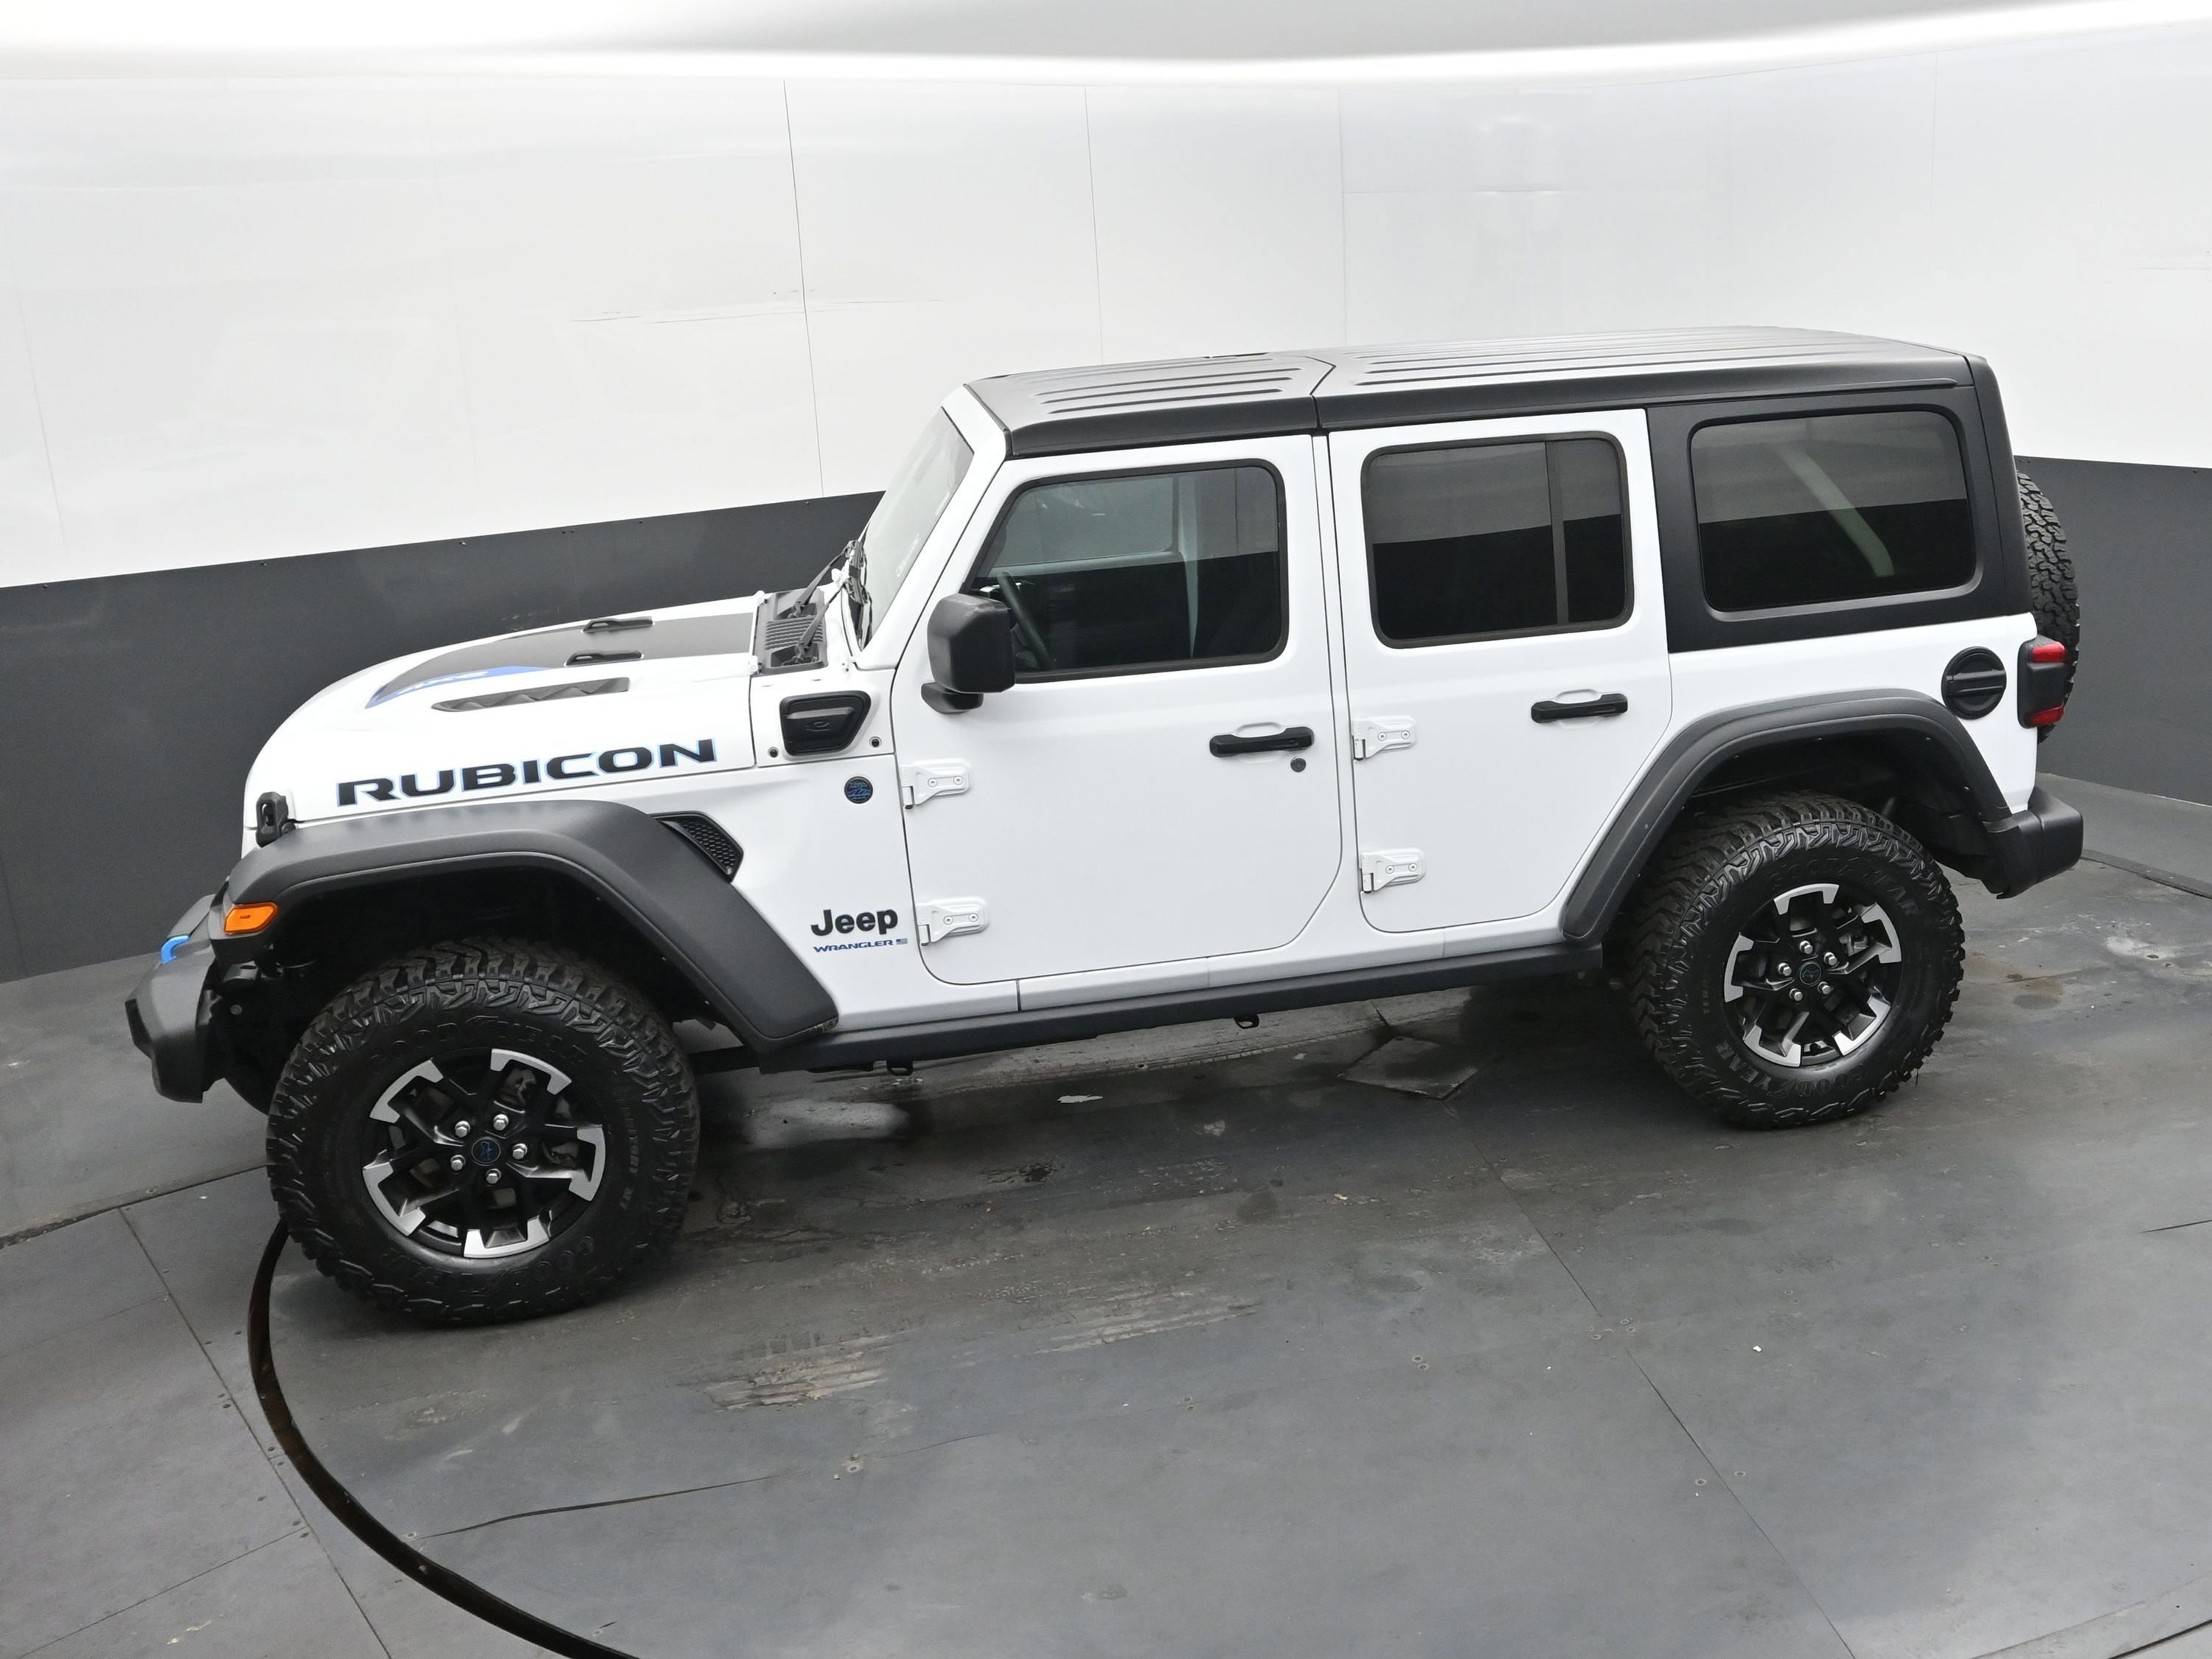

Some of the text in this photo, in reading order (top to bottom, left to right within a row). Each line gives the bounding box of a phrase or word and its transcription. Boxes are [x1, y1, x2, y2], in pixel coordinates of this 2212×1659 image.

[336, 737, 717, 807] RUBICON
[810, 908, 898, 936] Jeep
[813, 939, 894, 953] WRANGLER
